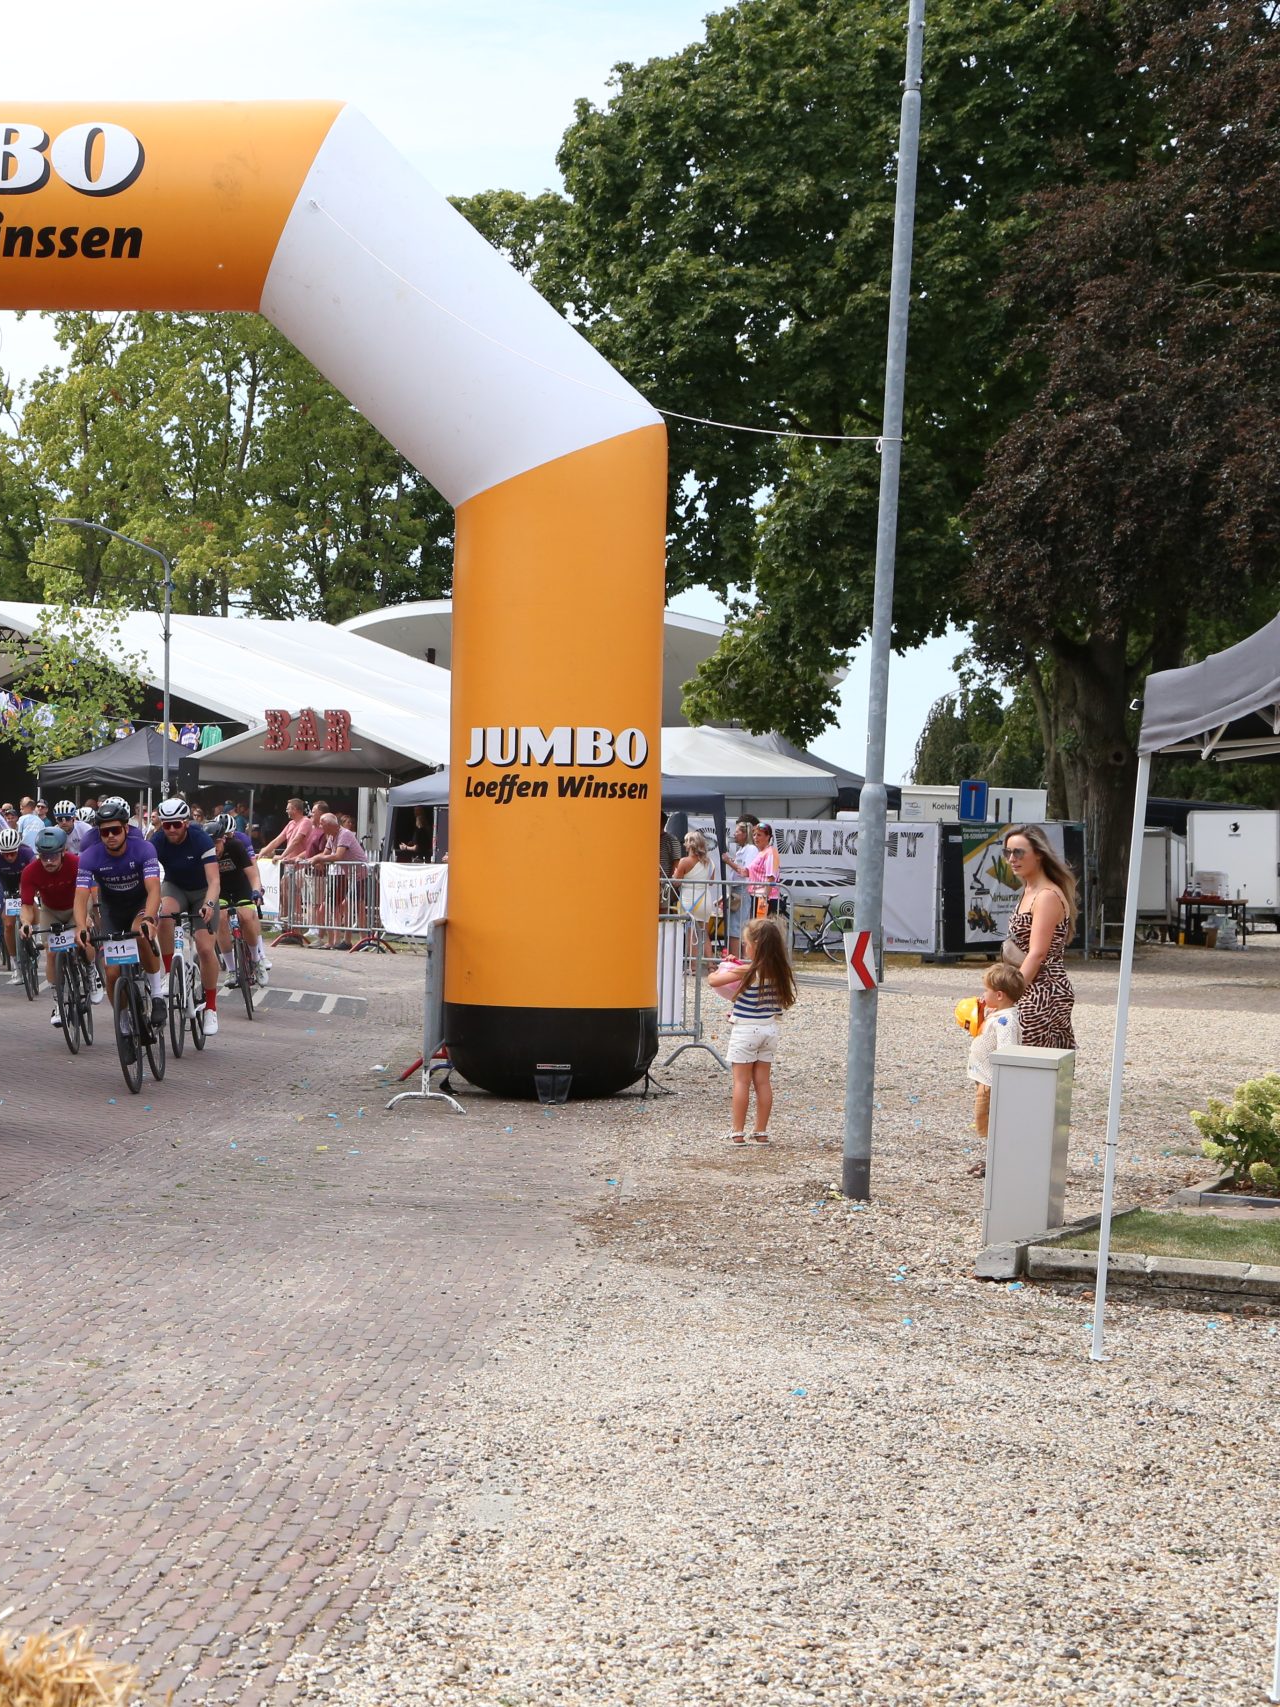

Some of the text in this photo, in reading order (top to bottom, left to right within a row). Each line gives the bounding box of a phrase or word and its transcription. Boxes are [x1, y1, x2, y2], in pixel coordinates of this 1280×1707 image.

[264, 708, 352, 752] BAR
[465, 726, 648, 769] JUMBO
[465, 773, 648, 805] Loeffen Winssen
[54, 934, 67, 944] 28
[174, 930, 184, 939] 32
[113, 944, 126, 954] 11
